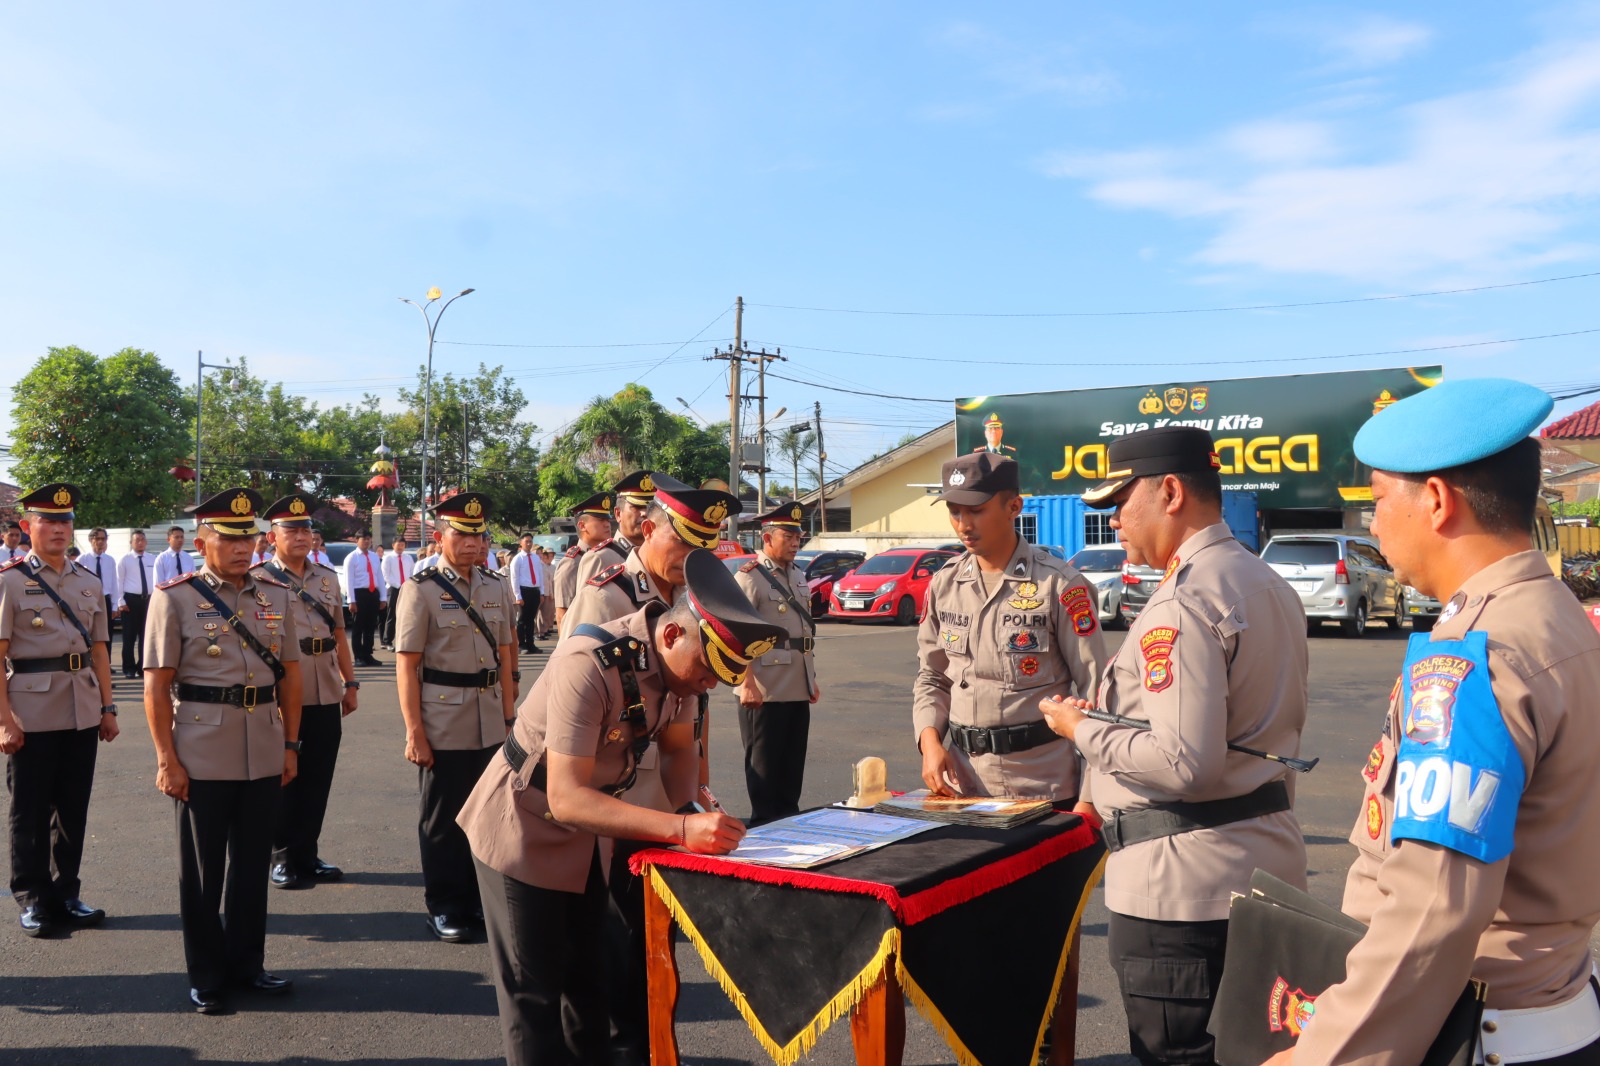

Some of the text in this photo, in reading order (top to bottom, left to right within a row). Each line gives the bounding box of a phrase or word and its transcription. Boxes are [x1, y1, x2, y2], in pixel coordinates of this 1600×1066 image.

[1217, 414, 1263, 431] Kita
[1243, 482, 1260, 490] dan
[1260, 481, 1280, 492] Maju
[1003, 613, 1047, 627] POLRI
[1142, 629, 1172, 645] POLRESTA
[1413, 657, 1467, 672] POLRESTA
[1413, 679, 1455, 691] LAMPUNG
[1394, 756, 1500, 832] ROV
[1271, 981, 1285, 1026] LAMPUNG
